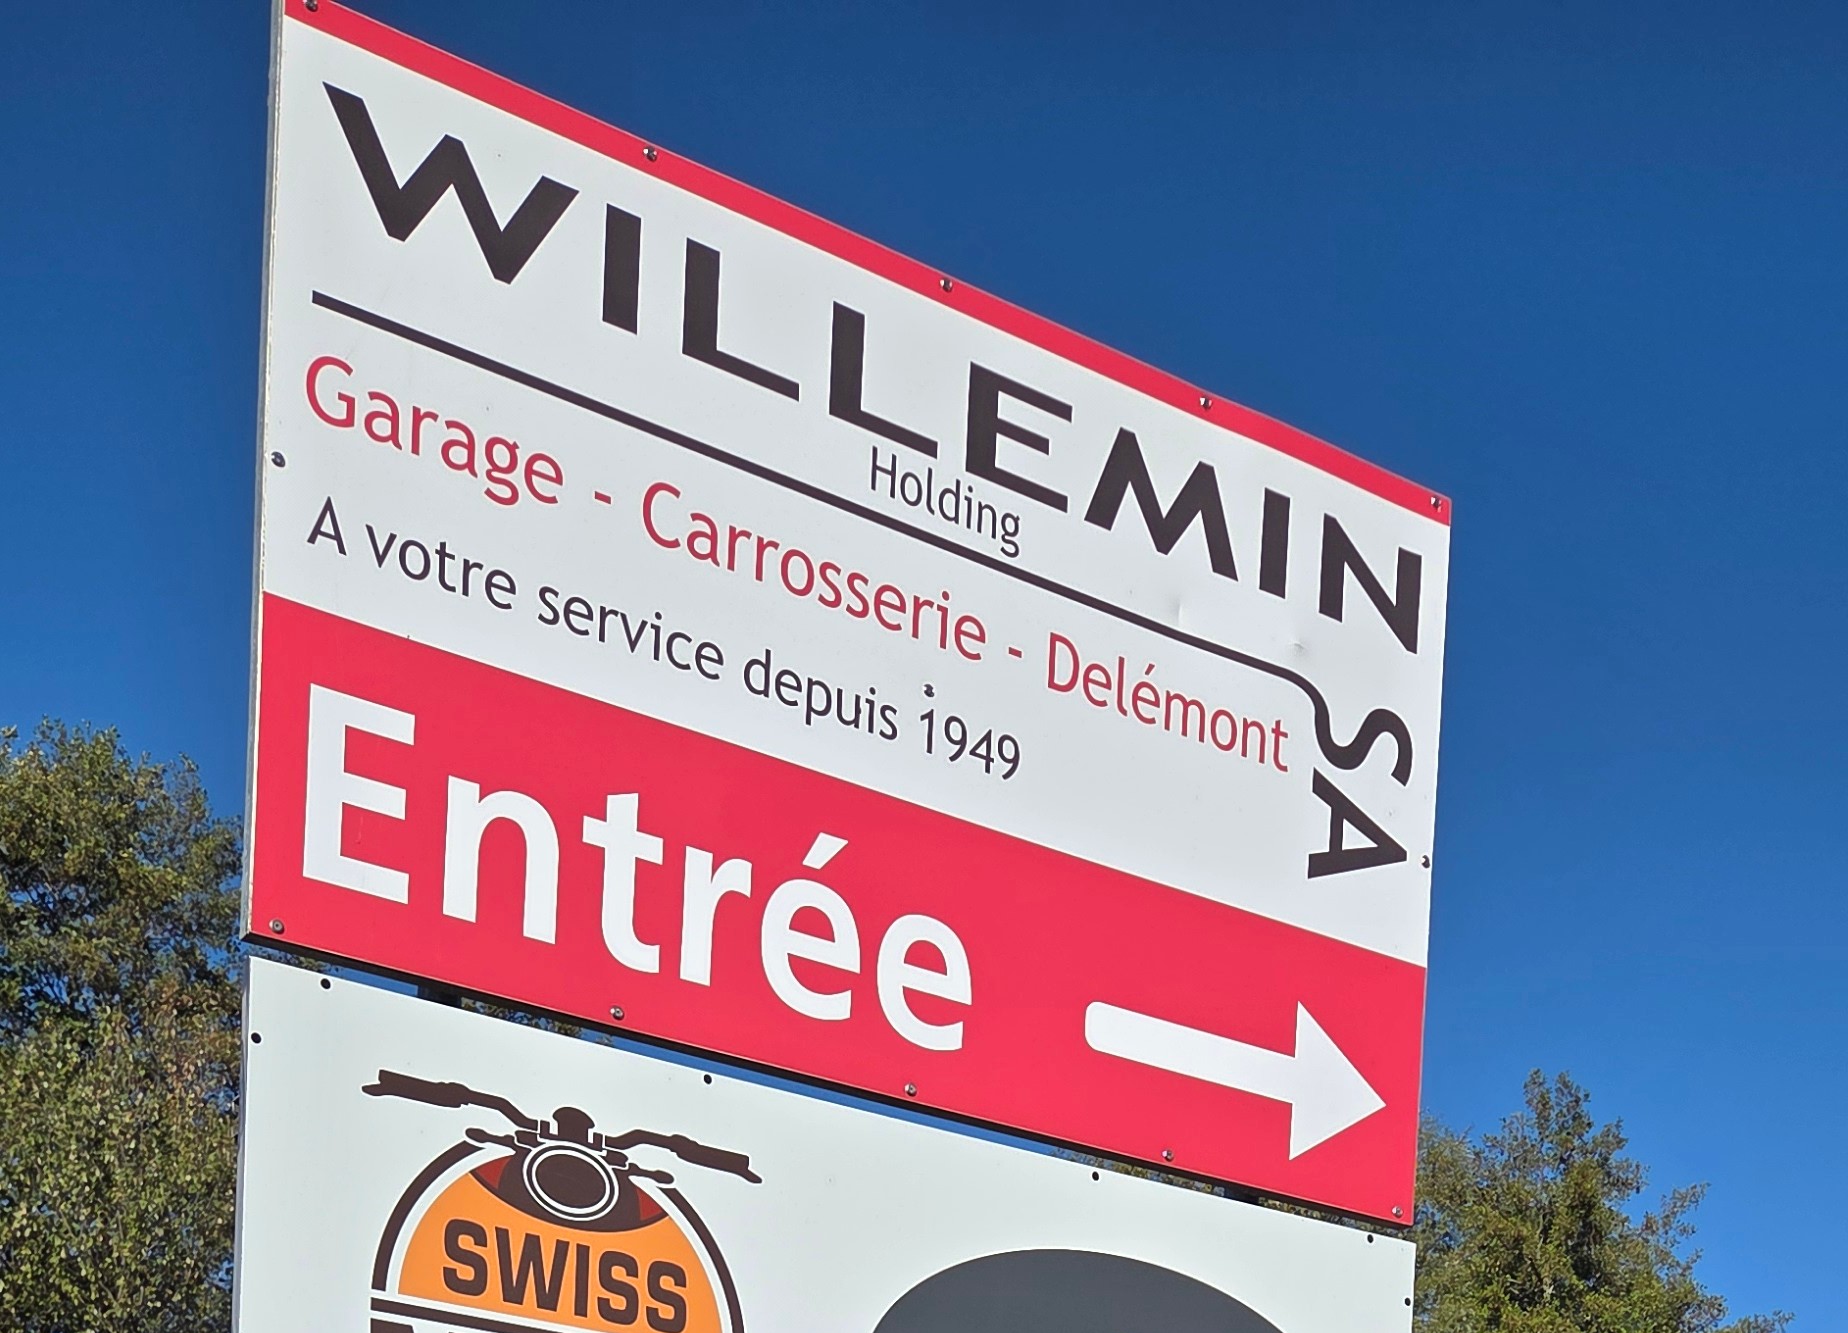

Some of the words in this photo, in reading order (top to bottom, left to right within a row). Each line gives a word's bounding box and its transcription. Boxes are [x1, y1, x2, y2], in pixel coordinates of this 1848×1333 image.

[322, 82, 1422, 655] WILLEMIN
[870, 445, 1020, 558] Holding
[305, 355, 564, 506] Garage
[642, 482, 987, 661] Carrosserie
[1047, 633, 1289, 774] Delémont
[307, 496, 347, 556] A
[366, 523, 517, 610] votre
[537, 582, 724, 680] service
[743, 648, 899, 742] depuis
[920, 706, 1021, 780] 1949
[302, 682, 972, 1051] Entrée
[1307, 706, 1413, 880] SA
